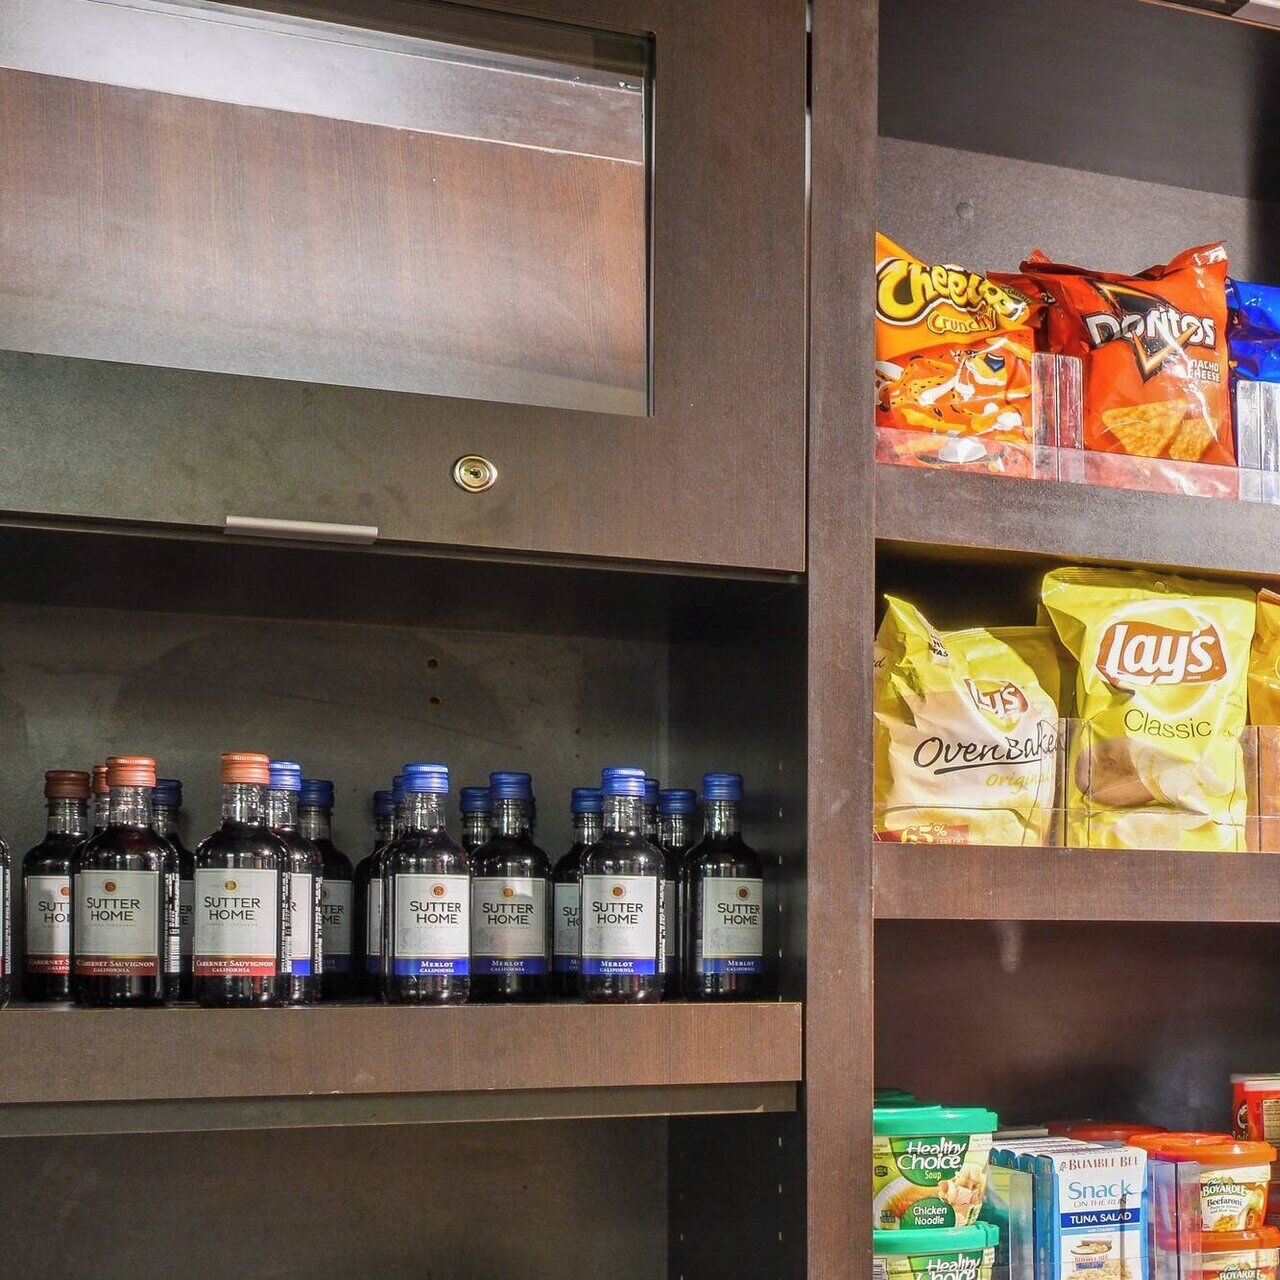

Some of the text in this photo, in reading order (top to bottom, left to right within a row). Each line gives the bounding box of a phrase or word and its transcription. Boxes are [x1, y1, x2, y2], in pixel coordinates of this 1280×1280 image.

[928, 311, 998, 334] Crunchy
[1085, 308, 1217, 349] Doritos
[1105, 624, 1214, 684] Lay's
[1123, 707, 1213, 739] Classic
[913, 735, 1005, 769] Oven
[86, 896, 141, 910] SUTTER
[203, 896, 261, 909] SUTTER
[409, 900, 462, 913] SUTTER
[482, 902, 534, 914] SUTTER
[592, 901, 644, 913] SUTTER
[717, 902, 761, 914] SUTTER
[90, 910, 134, 922] HOME
[208, 909, 255, 921] HOME
[416, 913, 458, 924] HOME
[487, 914, 530, 925] HOME
[596, 913, 639, 925] HOME
[723, 913, 759, 925] HOME
[109, 959, 155, 968] SAUVIGNON
[230, 960, 274, 968] SAUVIGNON
[420, 960, 454, 968] MERLOT
[906, 1136, 967, 1157] Healthy
[896, 1152, 964, 1171] Choice
[924, 1169, 943, 1181] Soup
[1067, 1179, 1132, 1200] Snack
[912, 1206, 948, 1216] Chicken
[913, 1215, 946, 1226] Noodle
[1069, 1211, 1132, 1224] TUNA SALAD
[926, 1253, 981, 1272] Healthy
